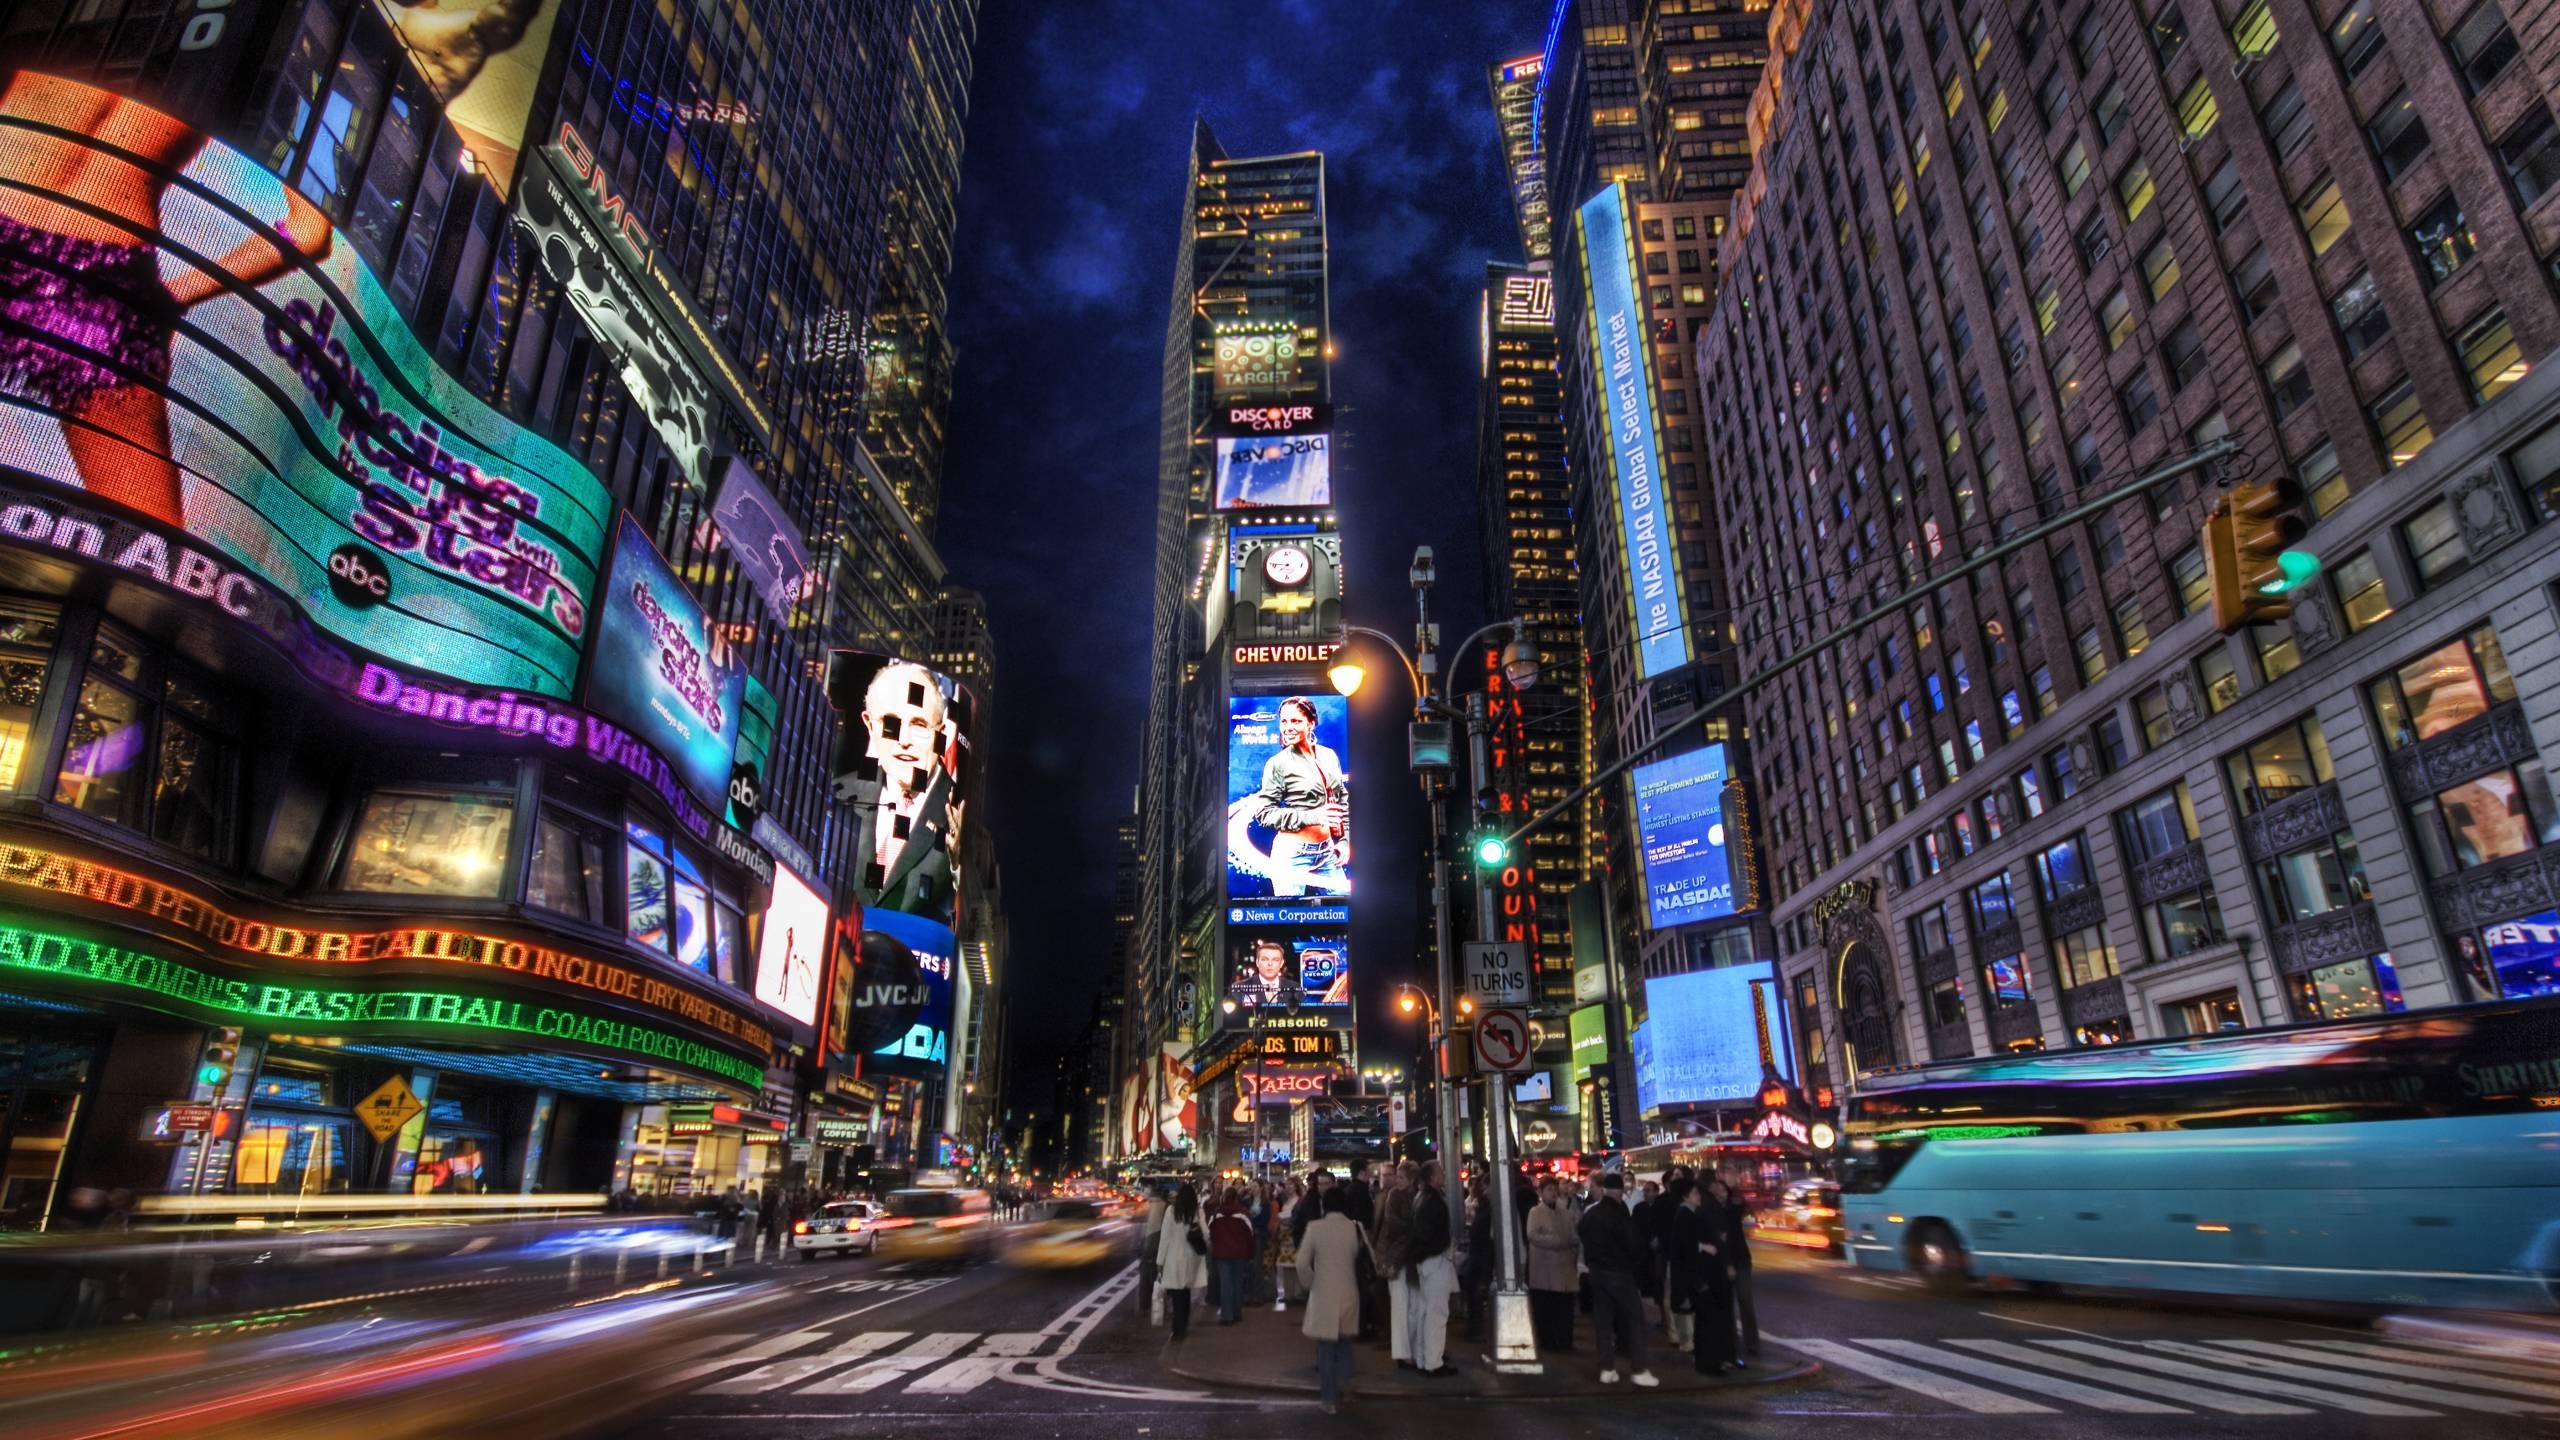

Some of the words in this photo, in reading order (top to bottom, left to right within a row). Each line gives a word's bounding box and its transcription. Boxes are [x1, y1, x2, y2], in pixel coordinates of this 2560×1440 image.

[559, 122, 649, 261] GMC
[547, 180, 562, 207] THE
[563, 203, 581, 230] NEW
[581, 226, 599, 253] 2007
[601, 251, 654, 328] YUKON
[654, 266, 670, 292] WE
[669, 290, 688, 318] ARE
[1609, 309, 1633, 378] Market
[1223, 371, 1291, 385] TARGET
[1230, 406, 1314, 423] DISCOVER
[1620, 379, 1642, 440] Select
[1253, 421, 1293, 430] CARD
[1625, 442, 1651, 508] Global
[0, 505, 105, 558] on
[113, 531, 258, 619] ABC
[514, 537, 559, 576] with
[1634, 509, 1659, 600] NASDAQ
[329, 553, 390, 598] abc
[1649, 601, 1668, 645] The
[357, 661, 579, 750] Dancing
[585, 714, 651, 782] With
[674, 788, 710, 841] Stars
[716, 823, 773, 886] Mondays
[1640, 789, 1654, 799] BEST
[1656, 779, 1694, 795] PERFORMING
[1694, 770, 1720, 783] MARKET
[1692, 875, 1707, 888] UP
[1245, 910, 1275, 922] News
[1278, 909, 1346, 923] Corporation
[1304, 959, 1333, 972] 80
[1482, 951, 1509, 969] NO
[534, 946, 640, 1000] INCLUDE
[642, 978, 679, 1011] DRY
[678, 990, 737, 1035] VARIETIES
[1471, 971, 1525, 991] TURNS
[856, 984, 909, 1008] JVC
[87, 943, 249, 1013] WOMEN'S
[258, 985, 530, 1032] BASKETBALL
[535, 1009, 625, 1049] COACH
[628, 1027, 687, 1061] POKEY
[685, 1041, 738, 1078] CHATMAN
[1292, 1037, 1318, 1053] TOM
[1704, 1084, 1741, 1098] ADDS
[375, 1109, 402, 1118] SHARE
[374, 1124, 395, 1132] ROAD
[673, 1123, 713, 1132] SEPHORA
[746, 1133, 780, 1142] SEPHORA
[823, 1130, 858, 1139] COFFEE
